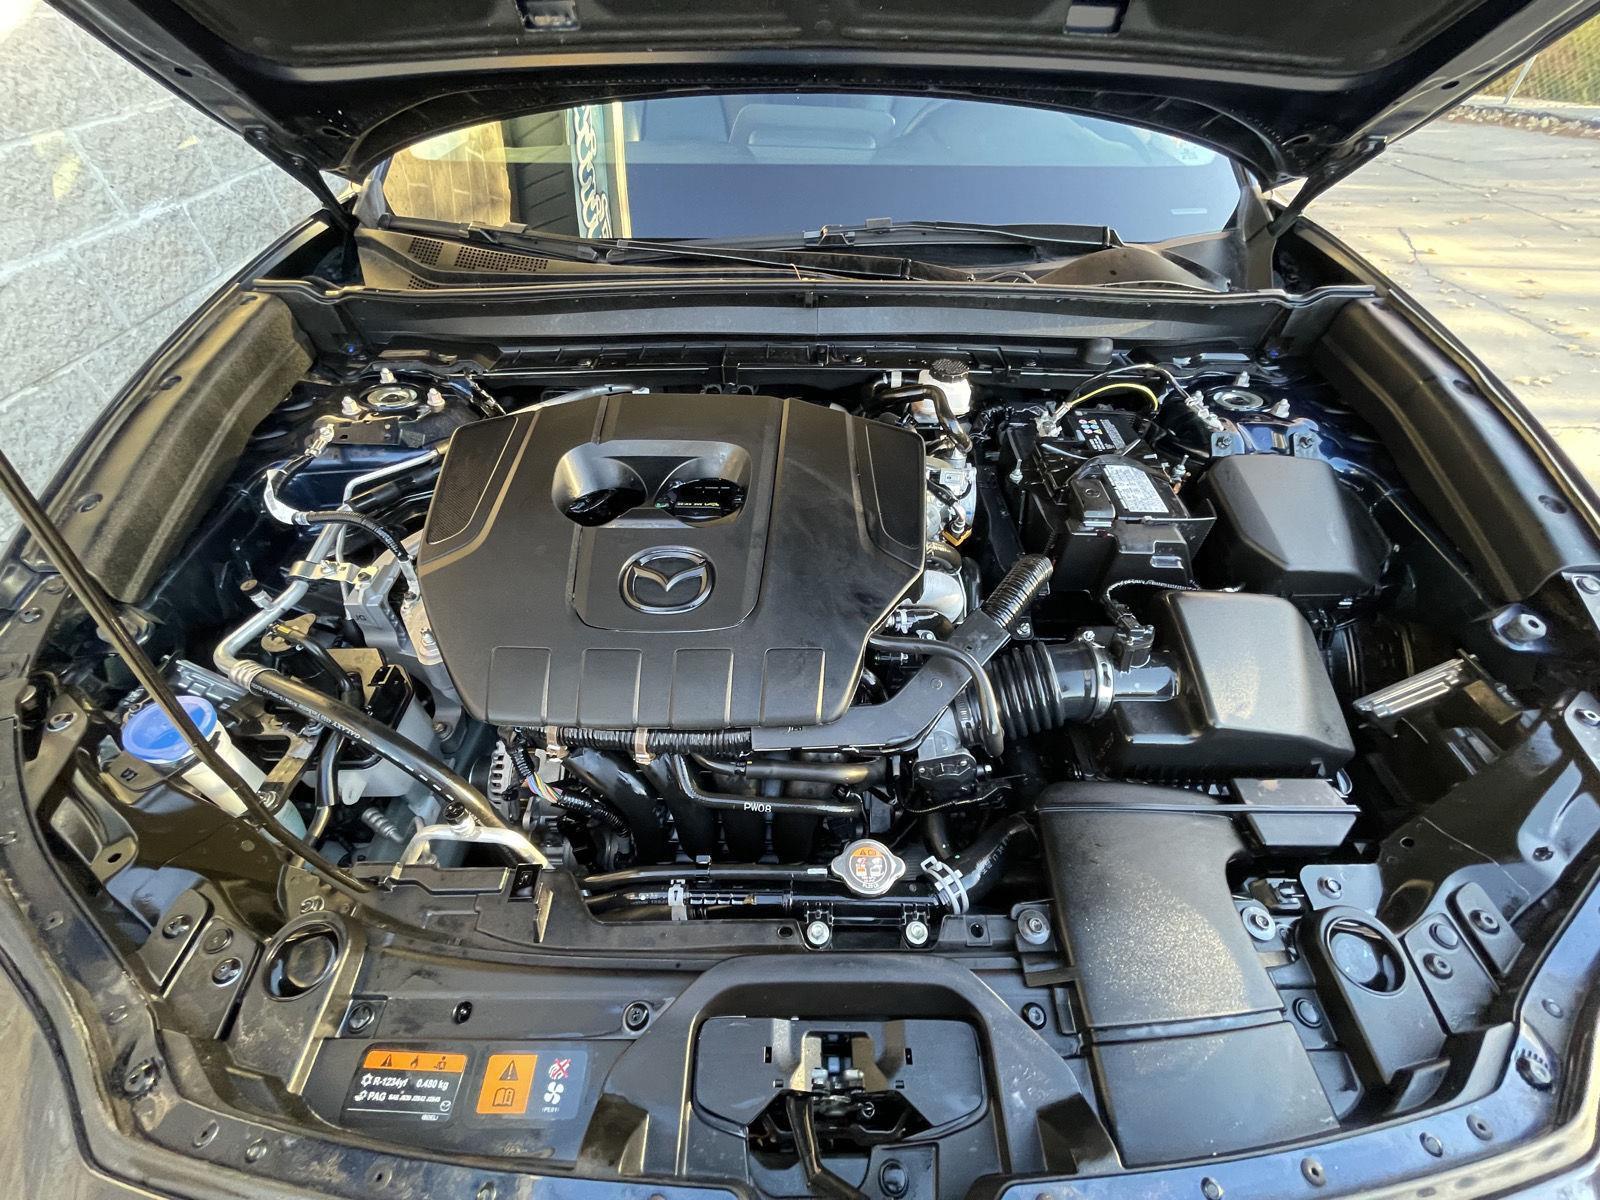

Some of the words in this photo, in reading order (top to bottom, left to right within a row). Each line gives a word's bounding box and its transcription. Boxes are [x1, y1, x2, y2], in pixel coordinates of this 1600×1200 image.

[331, 721, 361, 739] GALAXY
[743, 801, 772, 813] PW08
[438, 1080, 450, 1092] kg
[367, 1091, 387, 1102] PAG
